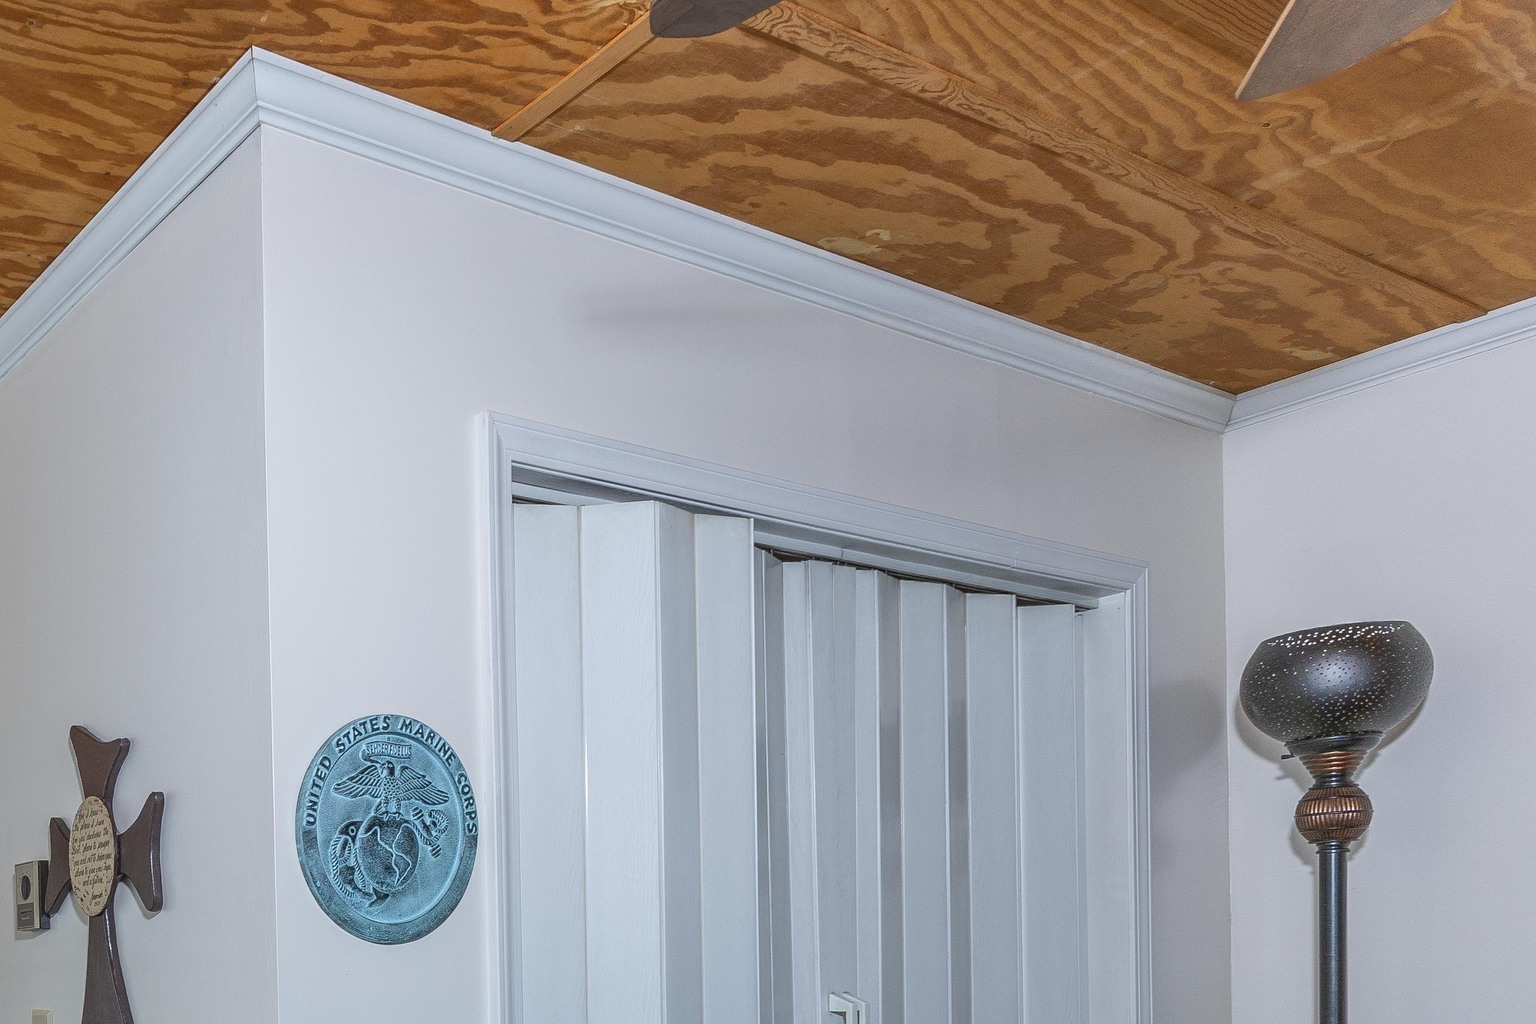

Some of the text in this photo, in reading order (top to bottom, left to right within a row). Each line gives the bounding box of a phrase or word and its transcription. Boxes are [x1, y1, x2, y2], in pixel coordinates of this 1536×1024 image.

[304, 716, 478, 835] UNITED STATES MARINE CORPS
